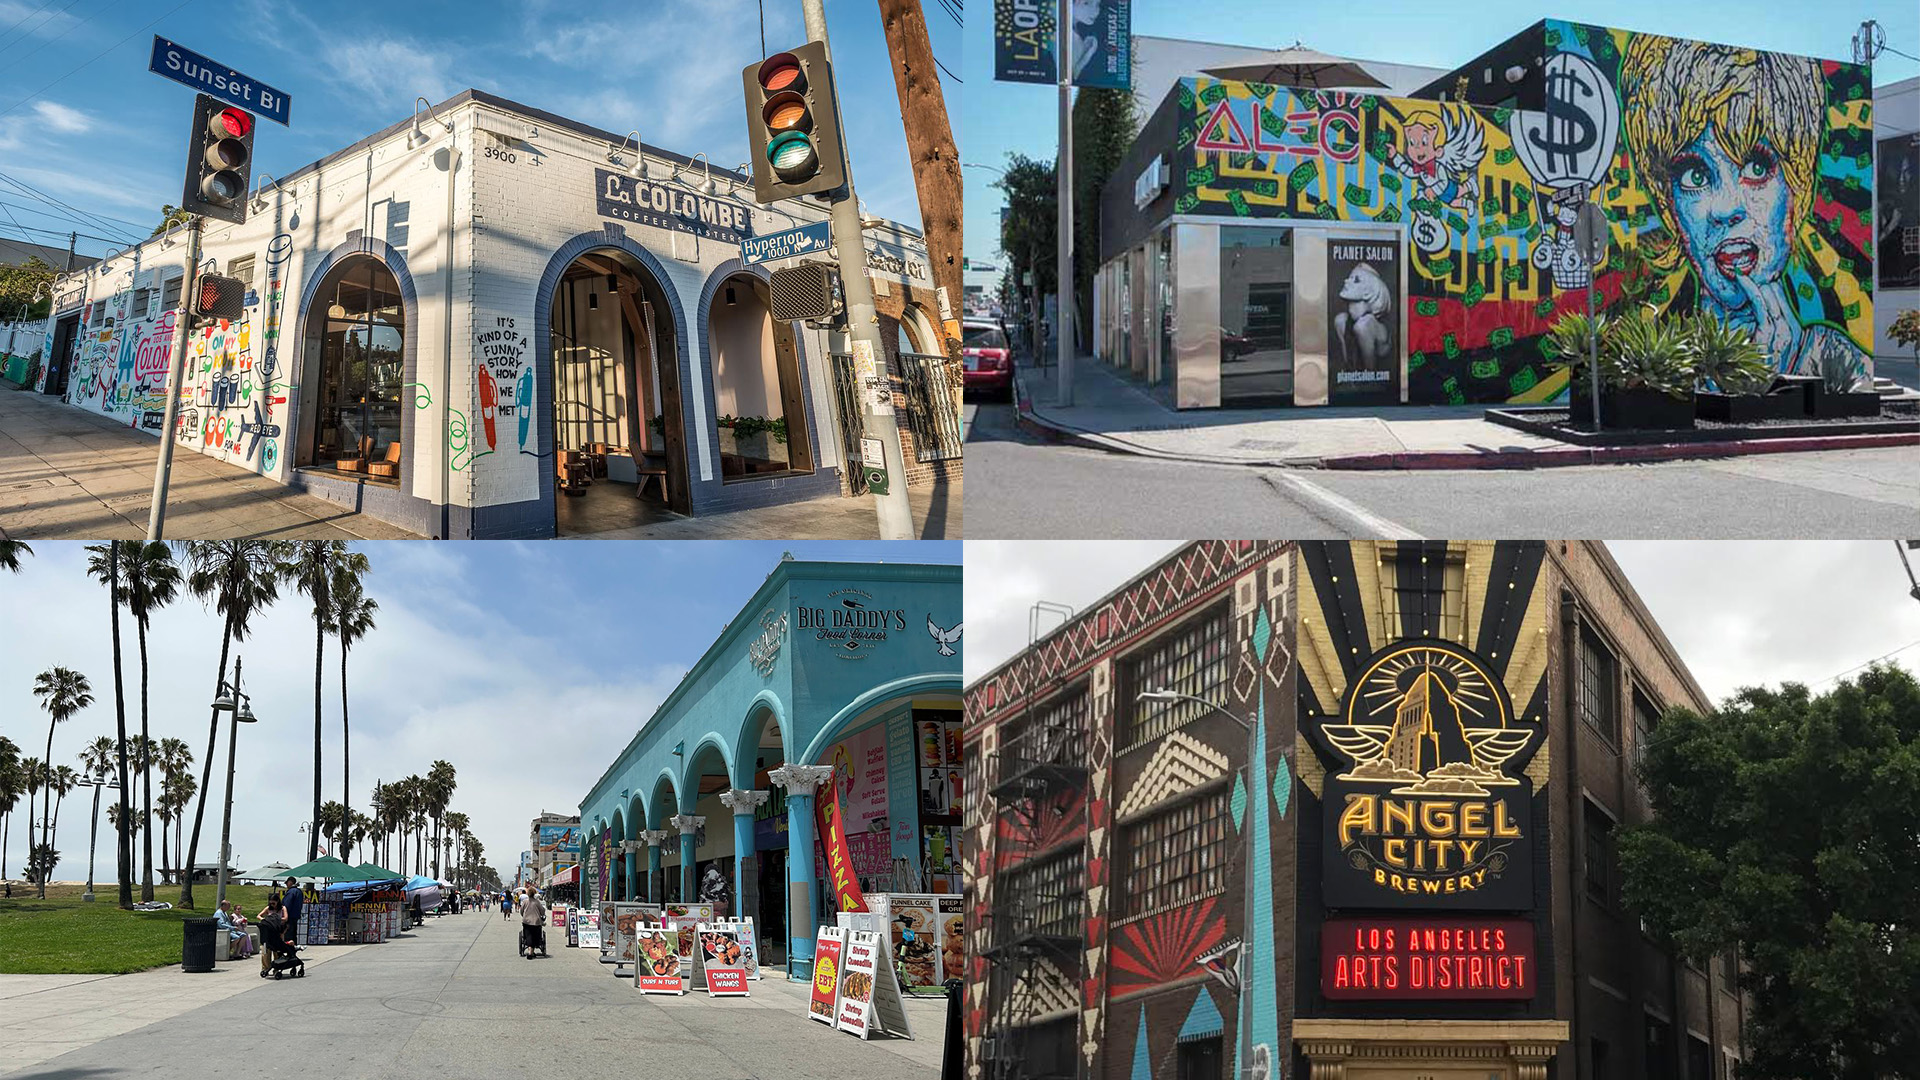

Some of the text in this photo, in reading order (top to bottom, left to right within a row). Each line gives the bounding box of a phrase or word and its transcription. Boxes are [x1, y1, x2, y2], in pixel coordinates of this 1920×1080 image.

[165, 50, 280, 113] Sunset Bl
[484, 147, 516, 164] 3900
[604, 175, 746, 231] La COLOMBE
[612, 207, 668, 228] COFFEE
[744, 231, 826, 255] Hyperion Av
[767, 246, 790, 259] 1000
[1333, 246, 1393, 260] PLANET SALON
[497, 317, 515, 328] IT'S
[212, 335, 236, 350] ON MY
[477, 330, 527, 348] KIND OF A
[483, 344, 523, 359] FUNNY
[487, 356, 523, 369] STORY
[496, 369, 518, 379] HOW
[500, 387, 513, 397] WE
[498, 405, 516, 416] MET
[249, 424, 273, 436] RED EYE
[797, 606, 906, 631] BIG DADDY'S
[815, 628, 889, 641] Food Corner
[1338, 793, 1524, 851] ANGEL
[823, 802, 859, 912] PIZZA
[1384, 839, 1483, 872] CITY
[1374, 868, 1488, 894] BREWERY
[372, 890, 406, 901] HENNA
[350, 903, 386, 913] HENNA
[1356, 929, 1505, 950] LOS ANGELES
[852, 946, 870, 957] Shrimp
[847, 957, 872, 968] Quesadilla
[712, 972, 739, 980] CHICKEN
[1335, 955, 1526, 989] ARTS DISTRICT
[818, 974, 833, 988] EBT
[845, 1003, 862, 1016] Shrimp
[840, 1013, 864, 1028] Quesadilla
